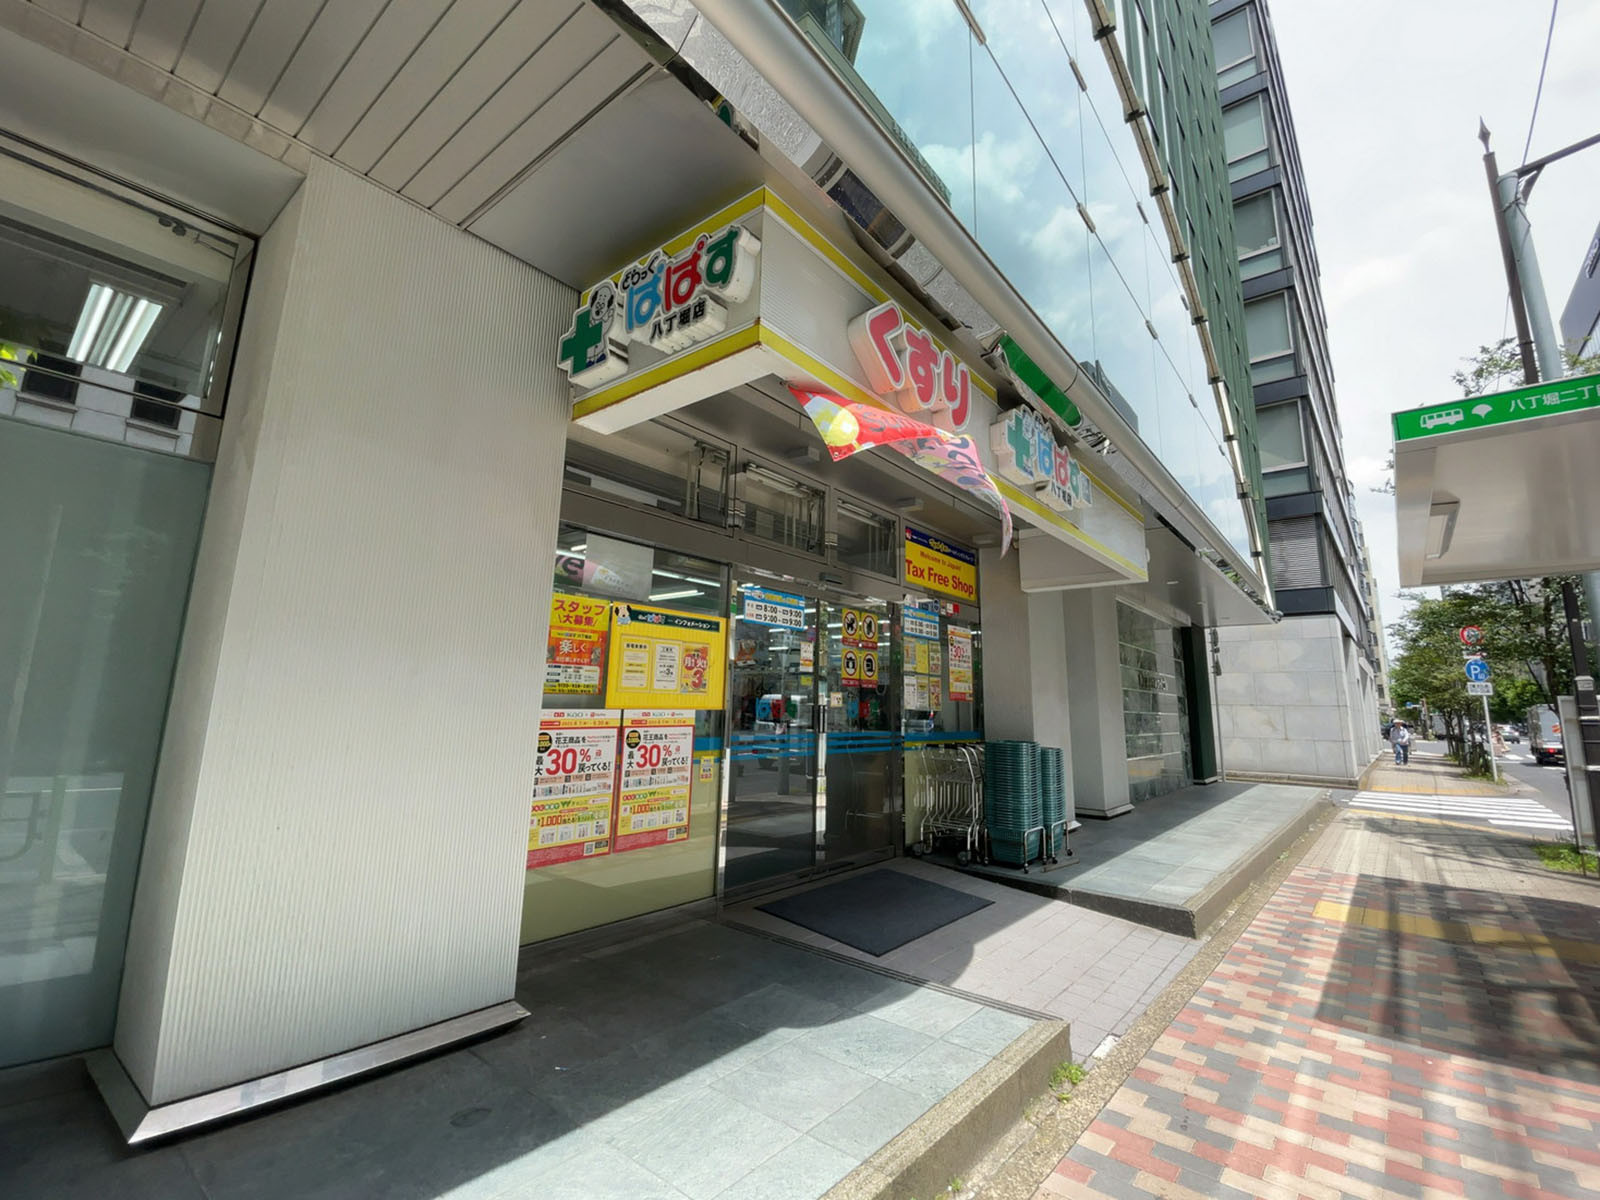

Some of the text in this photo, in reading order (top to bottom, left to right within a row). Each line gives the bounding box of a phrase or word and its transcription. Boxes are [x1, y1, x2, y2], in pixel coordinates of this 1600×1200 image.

[626, 229, 738, 331] ぱぱす
[651, 298, 706, 340] 八丁堀店
[869, 307, 968, 426] くすり
[1509, 384, 1600, 412] 八丁堀二丁
[905, 558, 974, 598] Tax Free Shop
[554, 599, 606, 616] スタッフ
